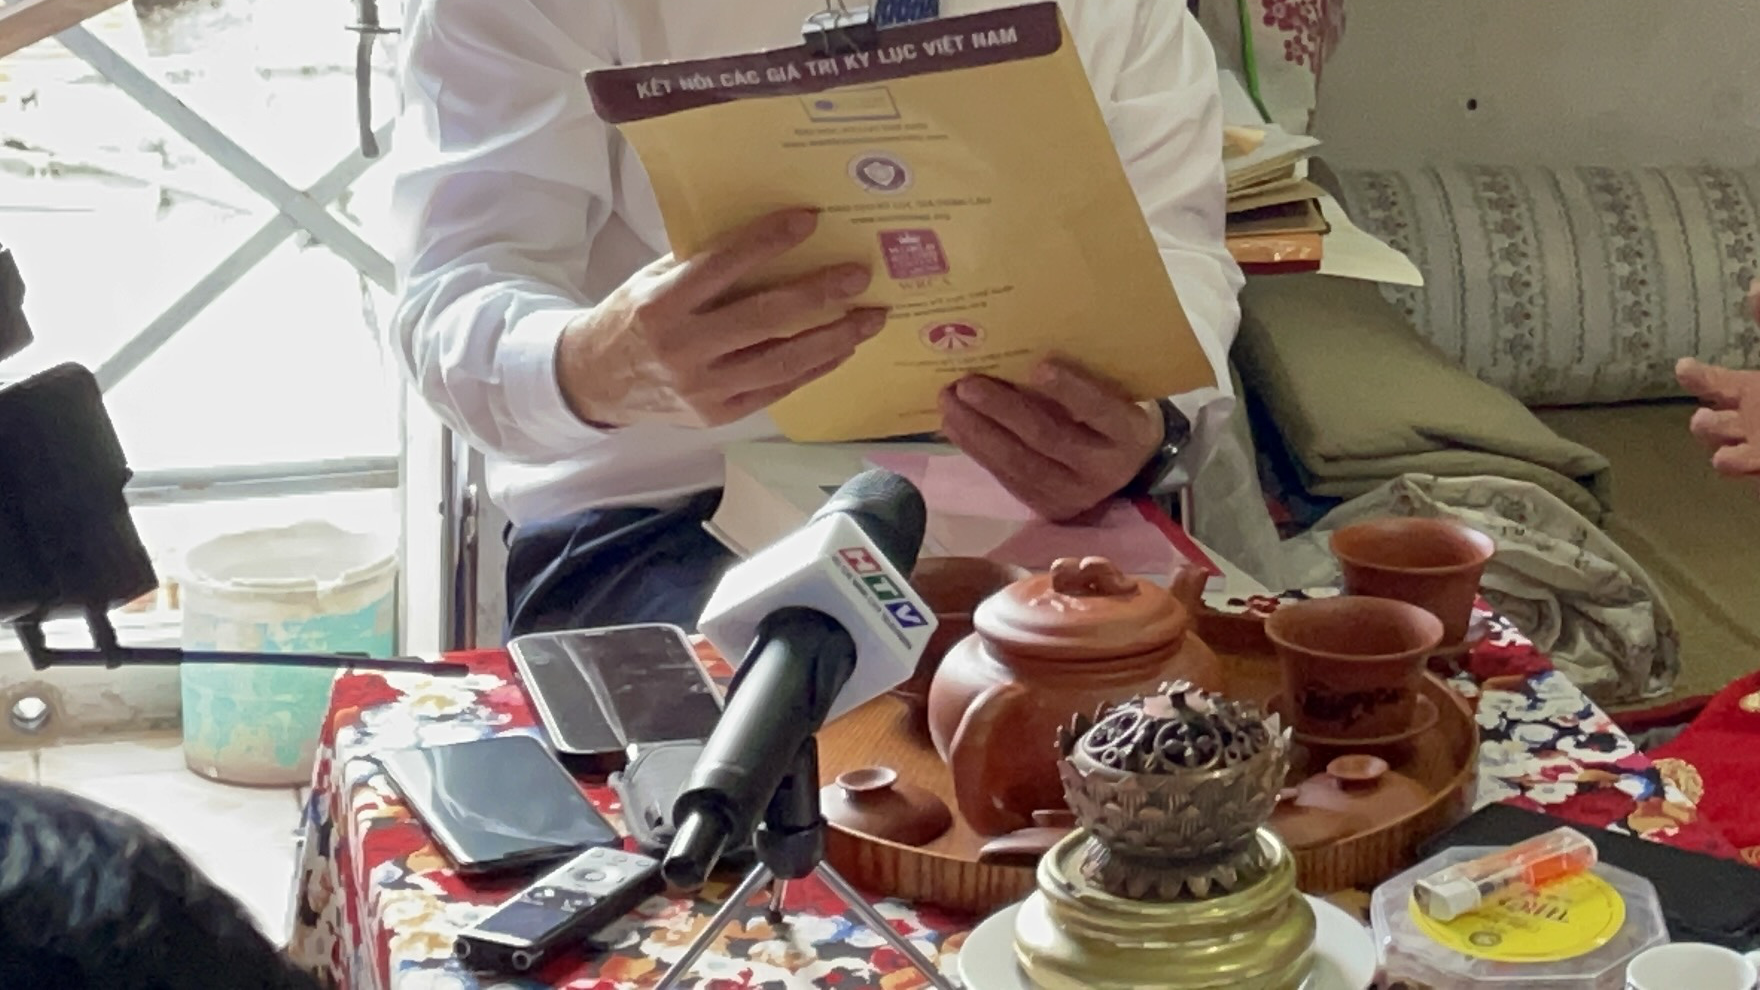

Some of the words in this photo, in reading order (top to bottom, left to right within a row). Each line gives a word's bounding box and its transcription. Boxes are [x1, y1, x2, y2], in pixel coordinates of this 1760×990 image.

[636, 76, 673, 99] KẾT
[678, 72, 715, 92] NỐI
[719, 65, 761, 88] CÁC
[765, 61, 802, 84] GIÁ
[804, 57, 840, 77] TRỊ
[876, 43, 918, 65] LỤC
[921, 34, 965, 57] VIỆT
[970, 25, 1019, 49] NAM
[837, 545, 929, 630] HTV
